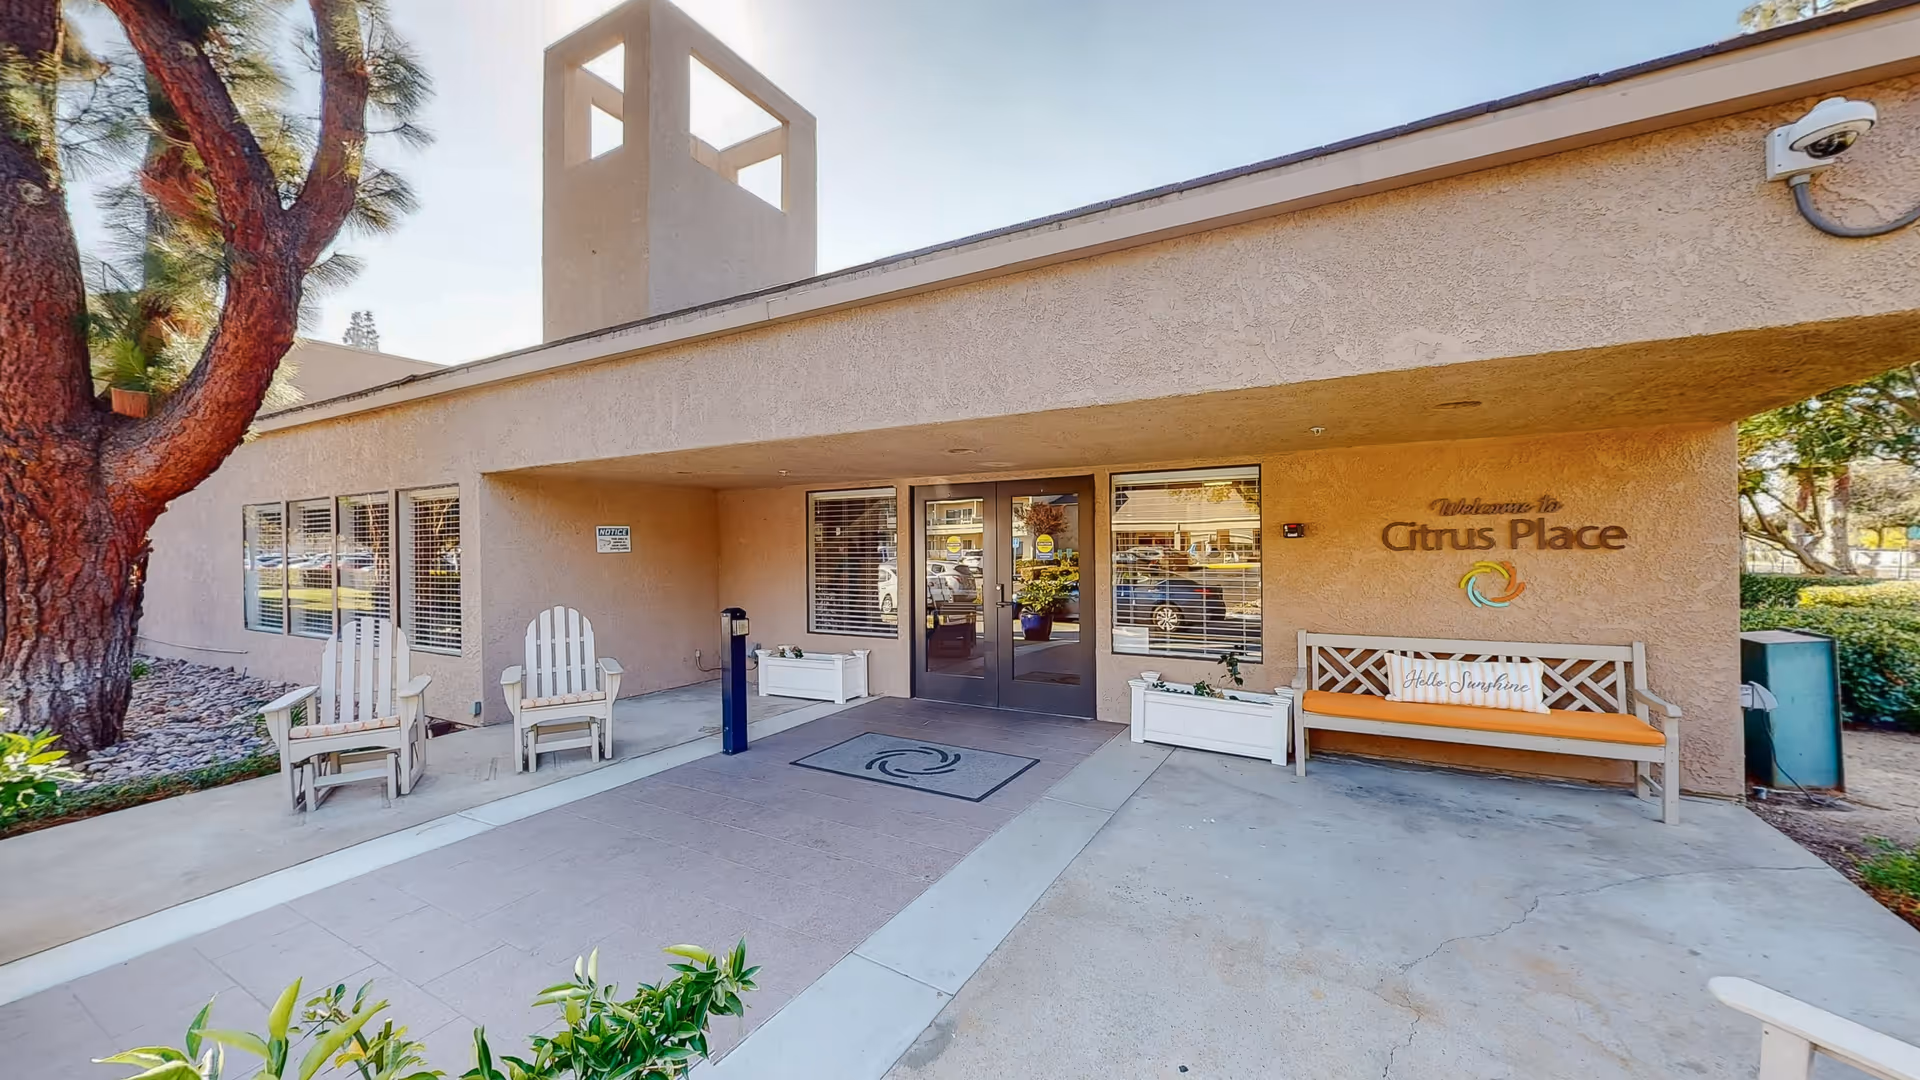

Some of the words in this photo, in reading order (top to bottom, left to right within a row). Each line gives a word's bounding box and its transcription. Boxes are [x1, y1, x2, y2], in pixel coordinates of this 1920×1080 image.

[1430, 497, 1534, 516] Welcome
[1537, 494, 1563, 514] to
[599, 528, 627, 536] NOTICE
[1382, 521, 1496, 551] Citrus
[1510, 518, 1628, 550] Place
[1449, 671, 1531, 693] Sunshine
